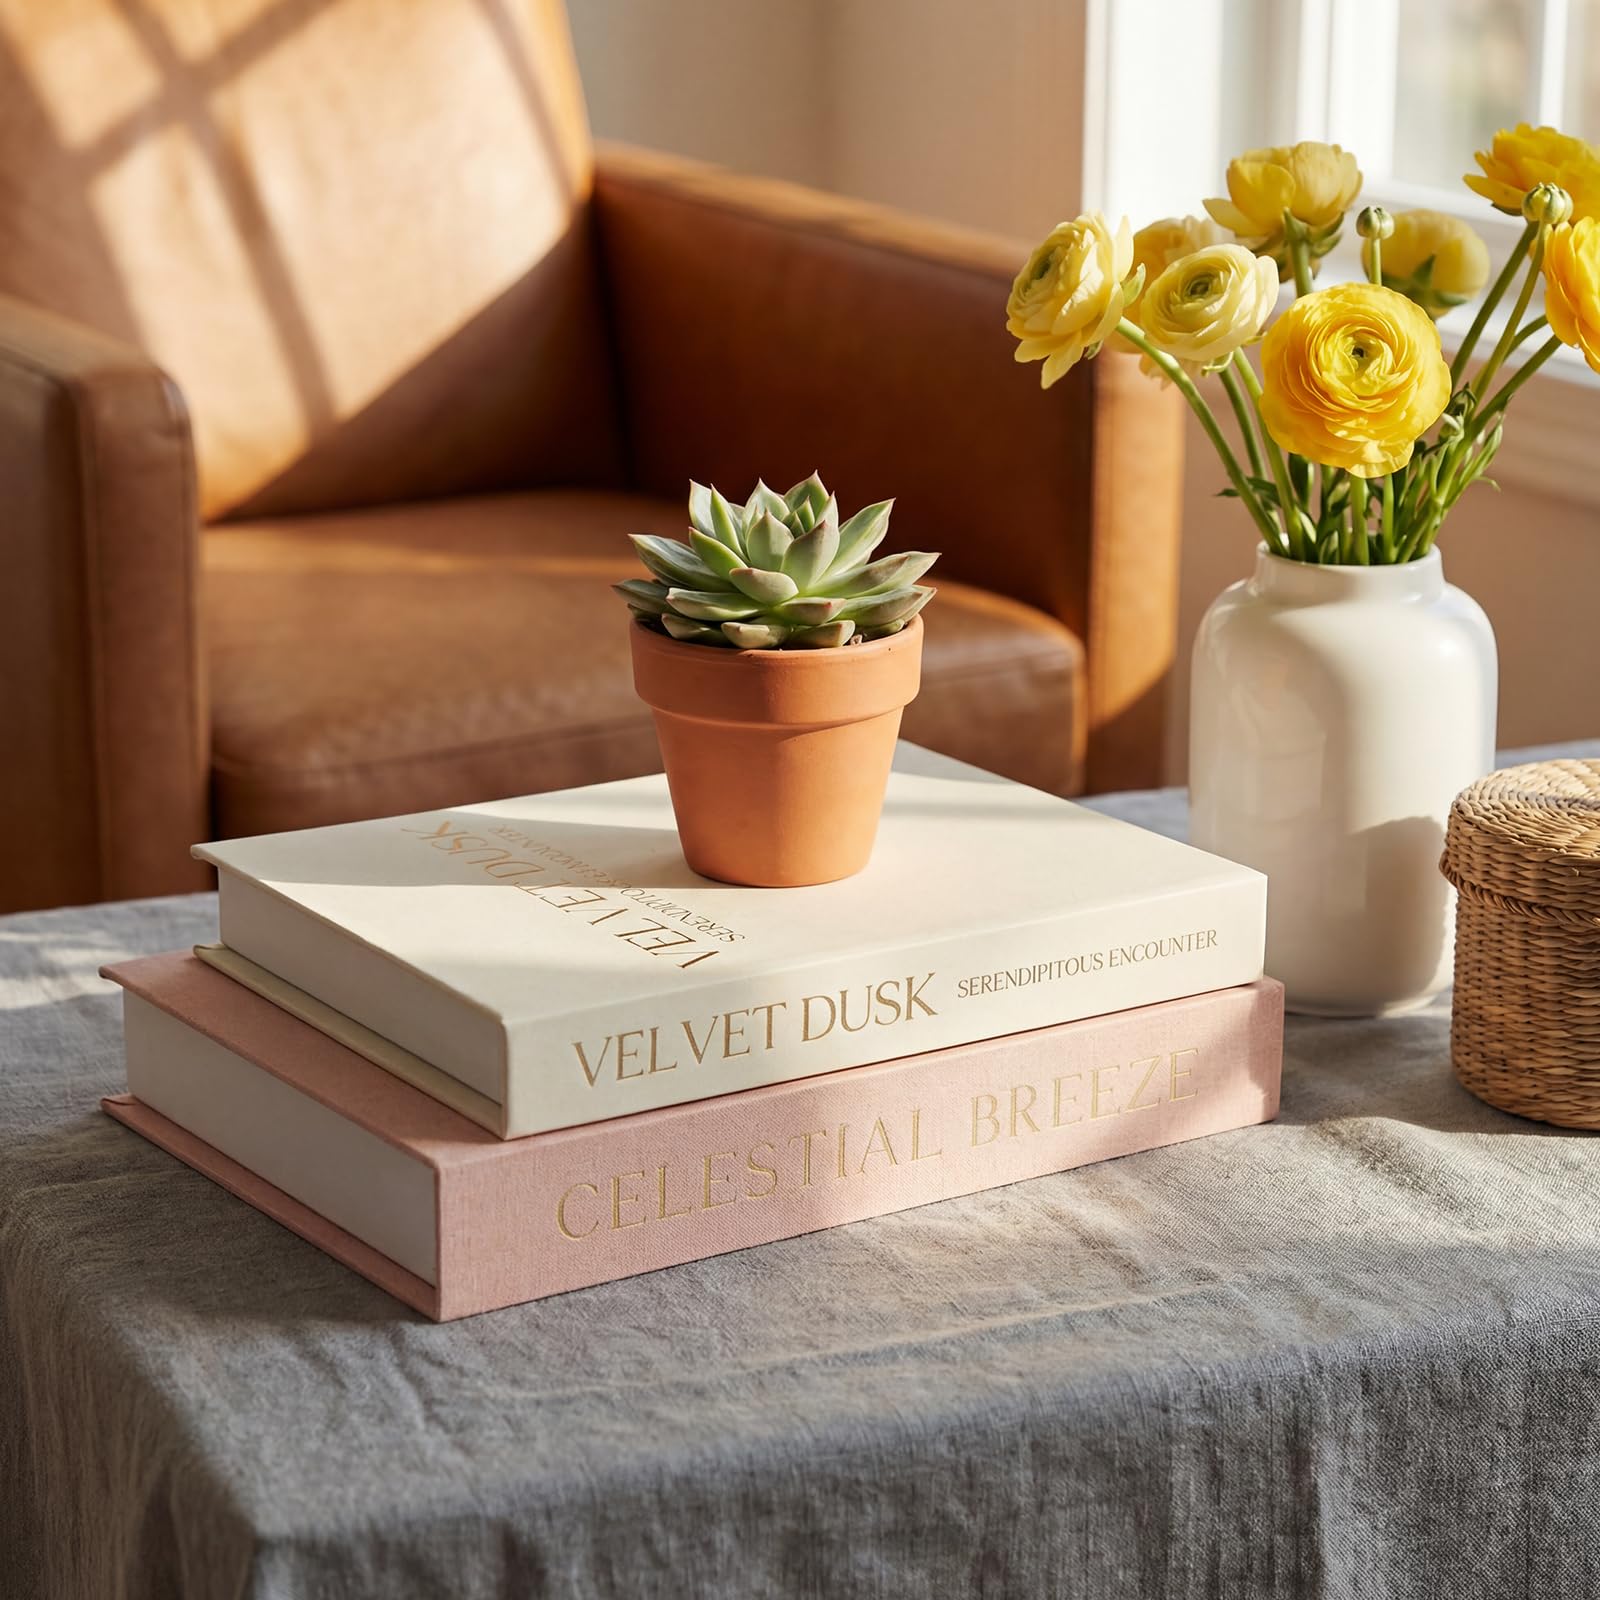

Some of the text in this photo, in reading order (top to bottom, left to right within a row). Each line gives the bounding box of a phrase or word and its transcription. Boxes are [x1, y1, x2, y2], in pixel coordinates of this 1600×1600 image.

[400, 820, 720, 969] VELVET DUSK
[571, 929, 1218, 1088] VELVET DUSK SERENDIPITOUS ENCOUNTER
[555, 1047, 1200, 1241] CELESTIAL BREEZE
